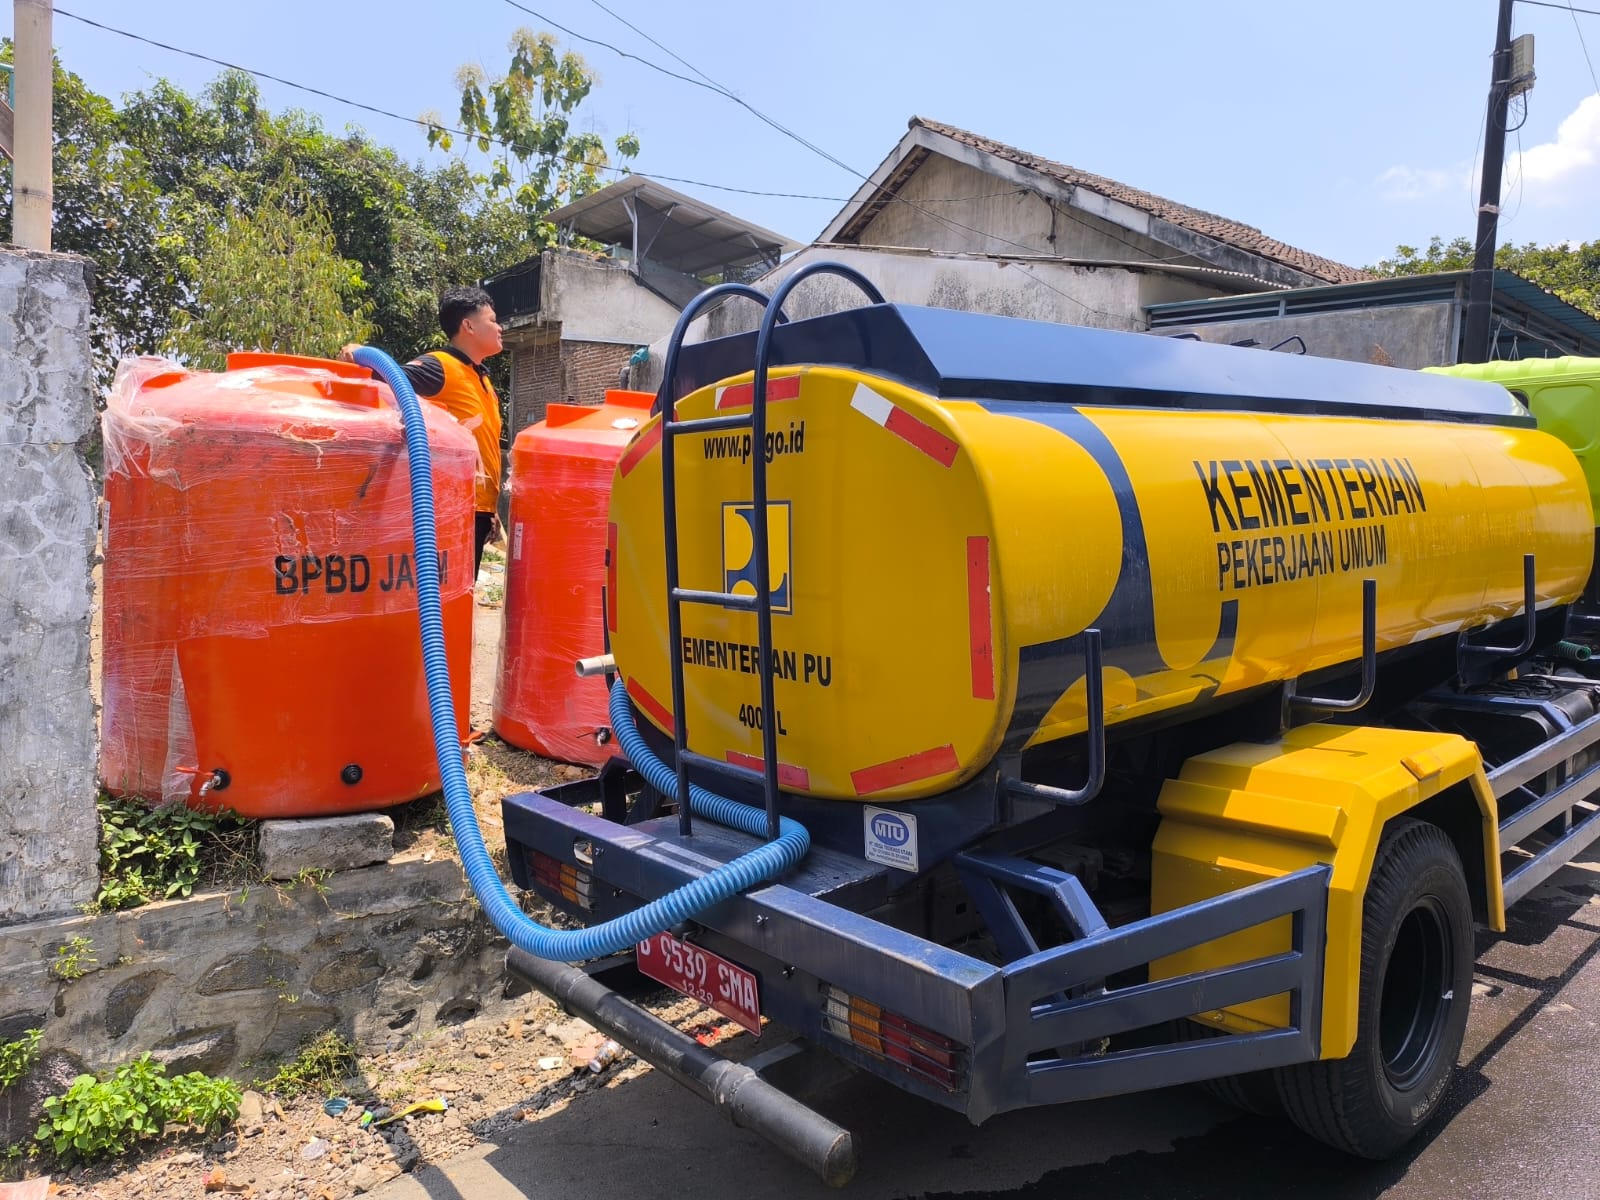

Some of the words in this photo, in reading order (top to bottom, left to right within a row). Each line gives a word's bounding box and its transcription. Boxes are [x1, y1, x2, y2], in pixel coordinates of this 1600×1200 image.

[703, 421, 805, 464] www.pgo.id
[1193, 458, 1427, 532] KEMENTERIAN
[274, 553, 371, 595] BPBD
[379, 550, 448, 592] JAM
[1216, 530, 1335, 591] PEKERJAAN
[1338, 524, 1387, 571] UMUM
[680, 636, 797, 681] EMENTERAN
[803, 653, 832, 687] PU
[739, 703, 766, 731] 400
[776, 710, 787, 736] L
[874, 819, 905, 841] MTU
[660, 935, 707, 987] 9539
